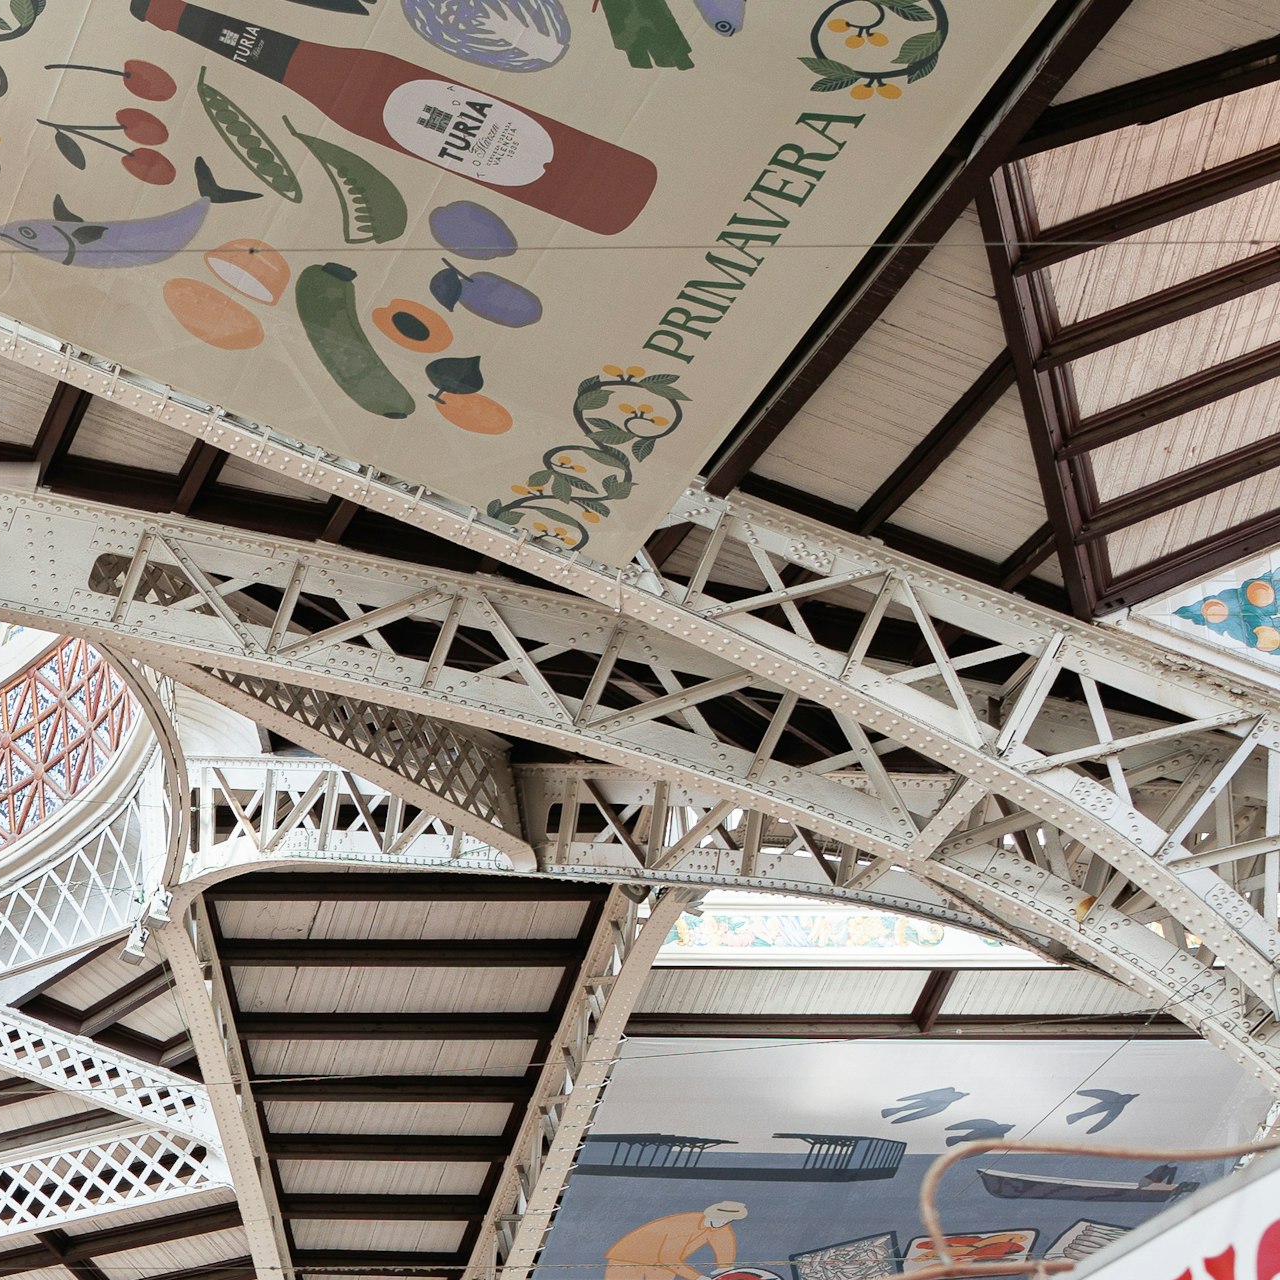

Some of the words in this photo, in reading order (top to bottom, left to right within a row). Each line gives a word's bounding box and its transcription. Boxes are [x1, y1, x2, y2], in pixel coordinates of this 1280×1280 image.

[233, 26, 260, 62] TURIA
[438, 101, 493, 162] TURIA
[493, 127, 518, 166] VALENCIA
[642, 112, 866, 364] PRIMAVERA
